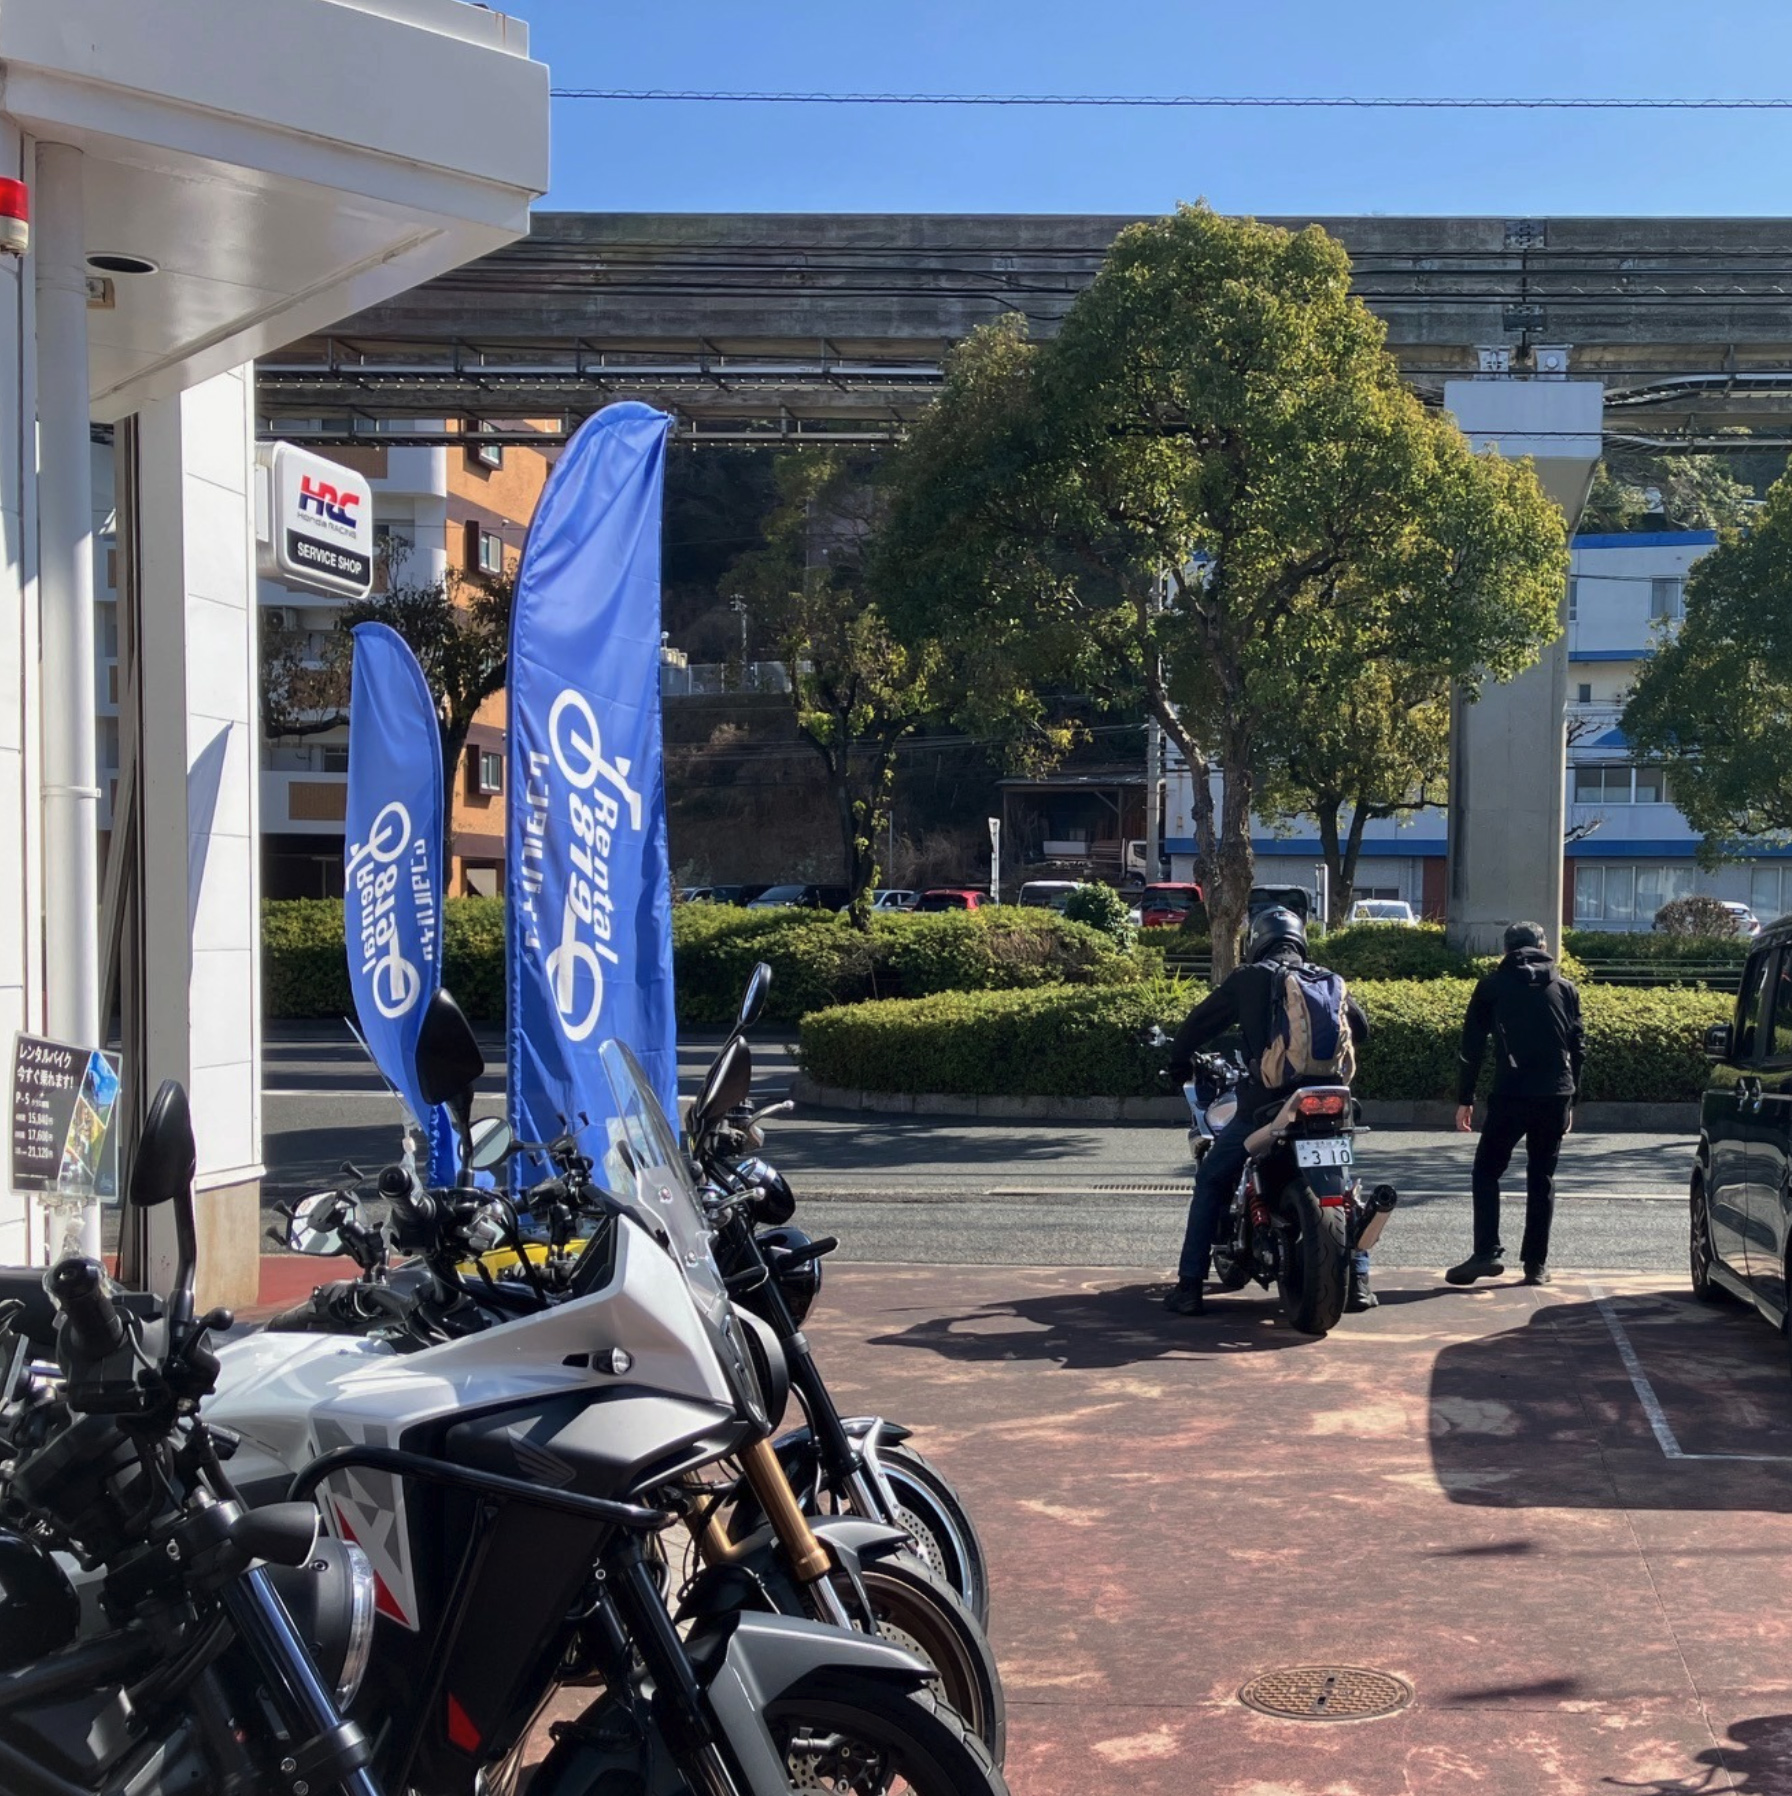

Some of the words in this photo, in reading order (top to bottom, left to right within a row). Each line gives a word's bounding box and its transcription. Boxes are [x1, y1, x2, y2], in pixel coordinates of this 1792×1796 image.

[297, 511, 327, 529] Honda
[298, 475, 360, 529] HRC
[297, 542, 337, 568] SERVICE
[338, 555, 362, 575] SHOP
[520, 750, 551, 951] レンタルバイク
[568, 791, 595, 927] 819
[594, 786, 619, 965] Rental
[20, 1043, 72, 1069] レンタルバイク
